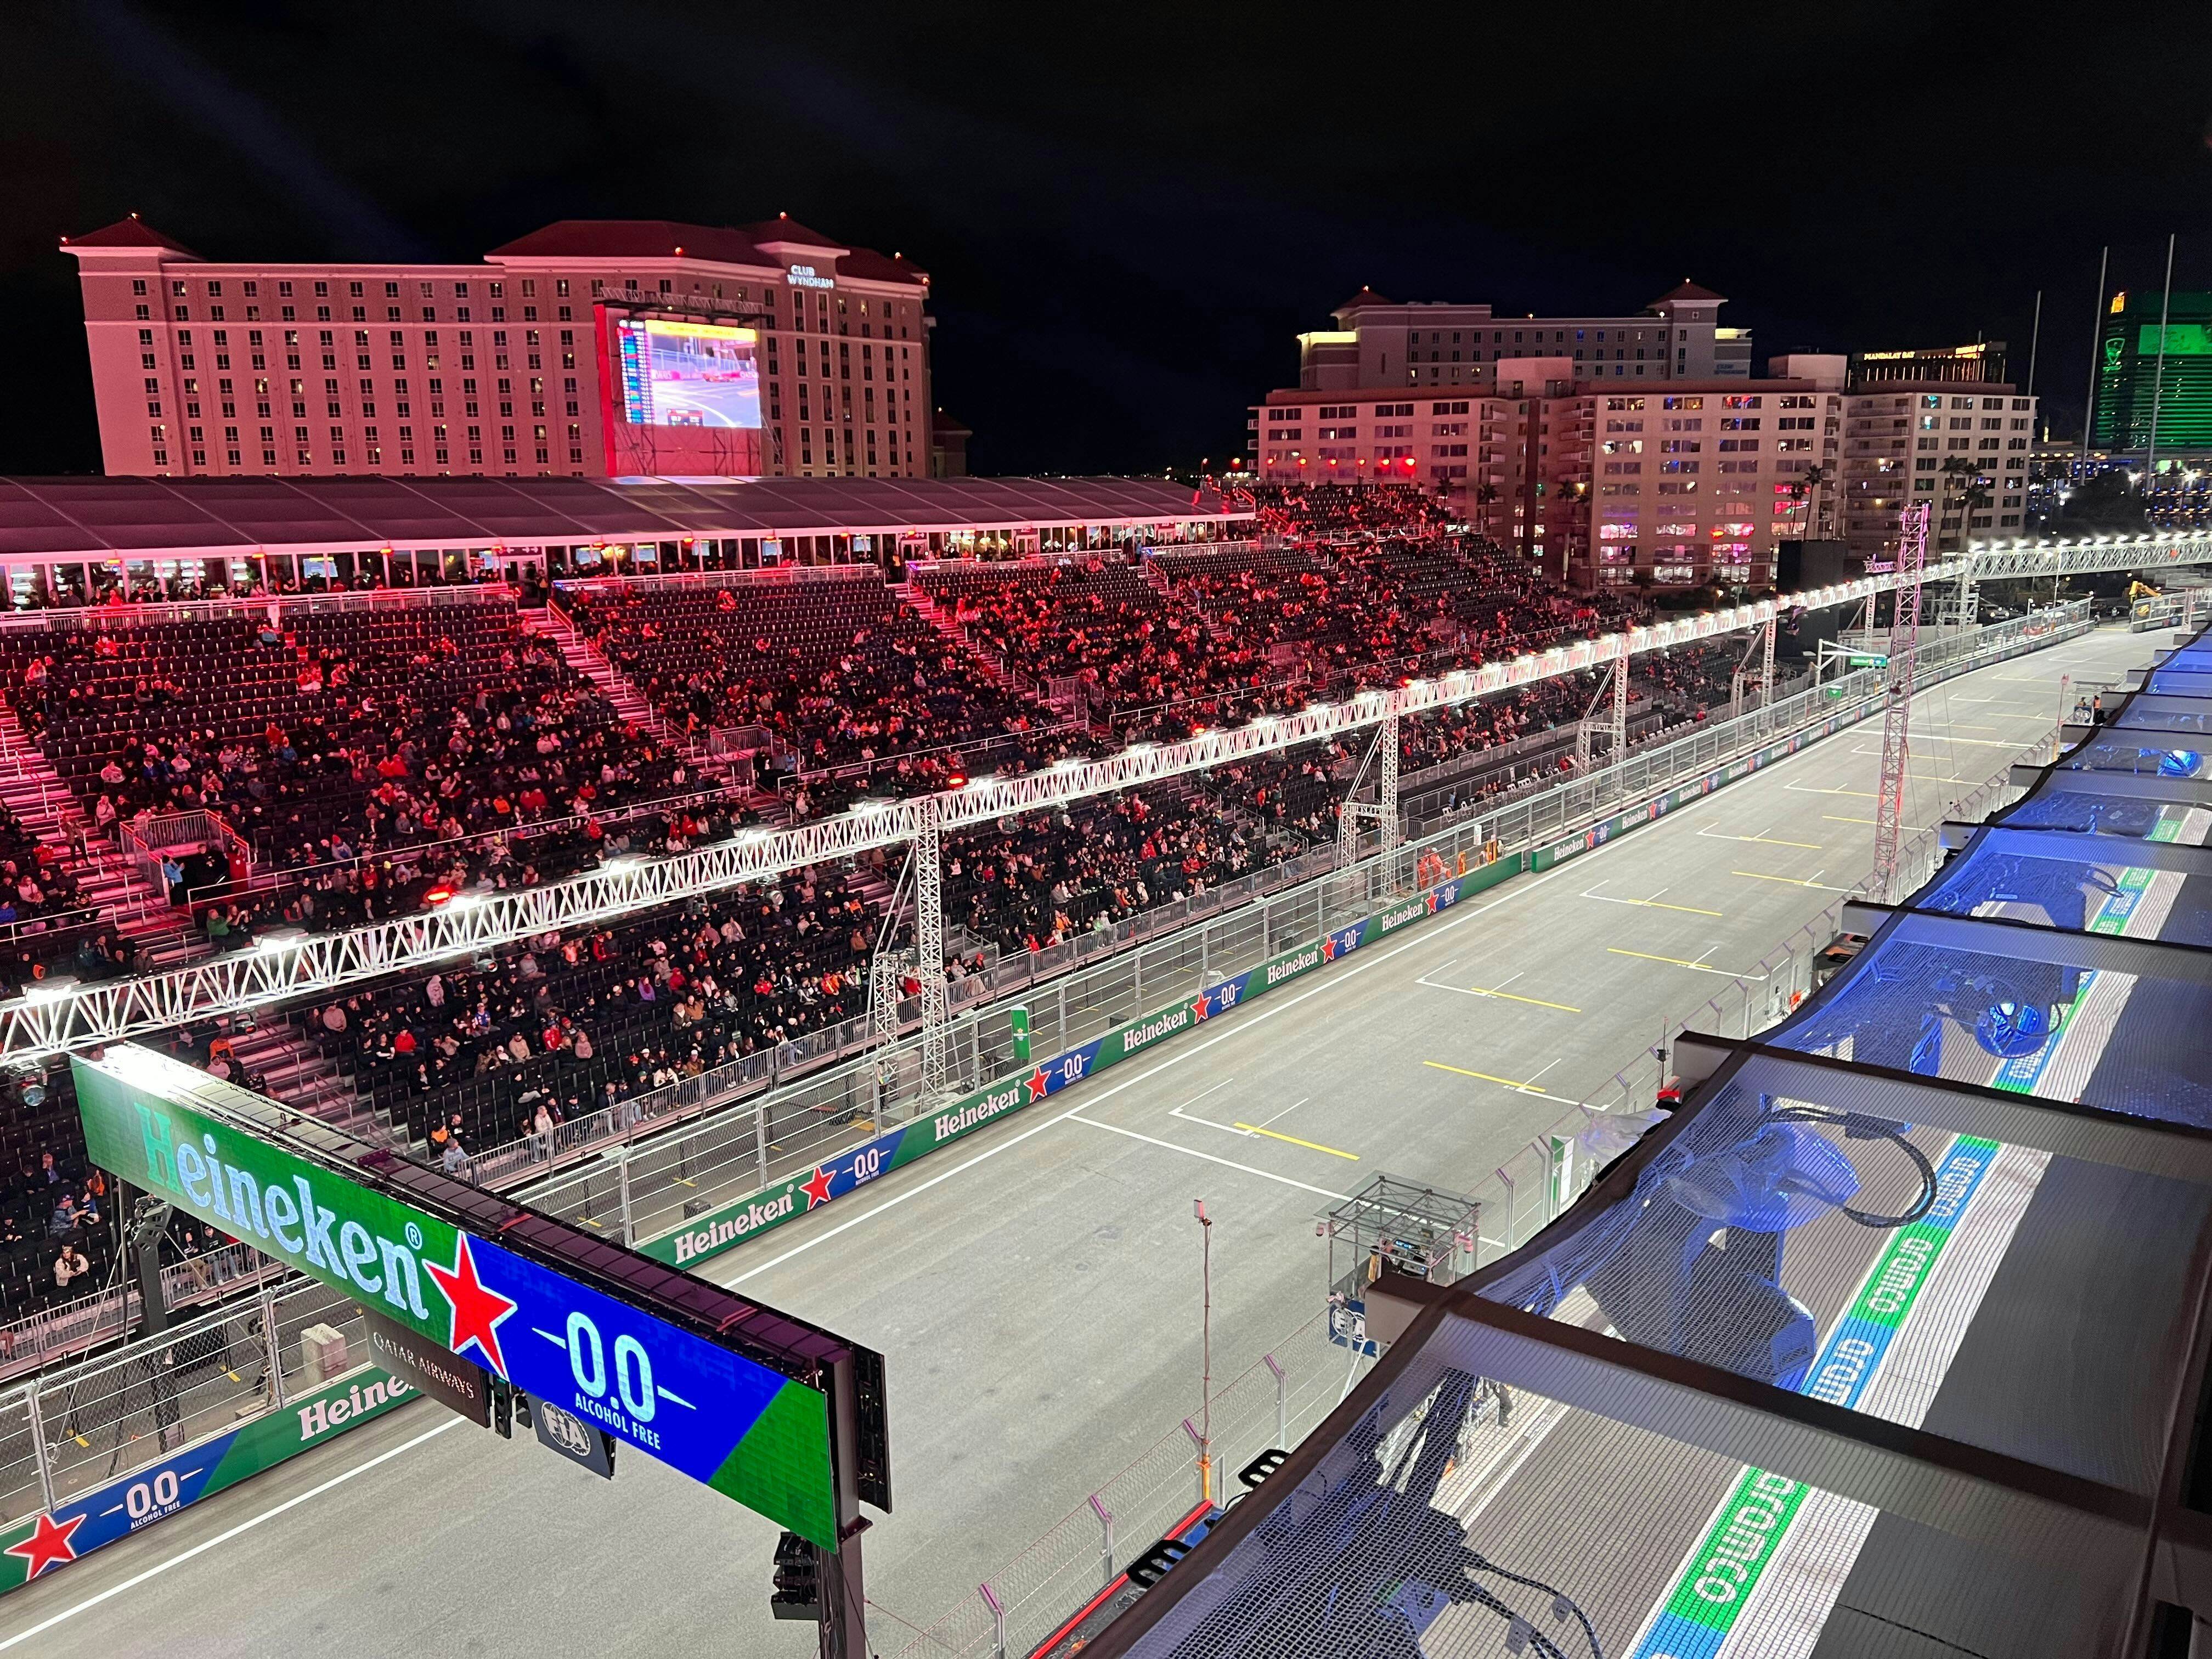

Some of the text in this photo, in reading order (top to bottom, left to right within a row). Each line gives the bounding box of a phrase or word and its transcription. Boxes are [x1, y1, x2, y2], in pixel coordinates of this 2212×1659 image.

[787, 274, 833, 289] WYNDHAM
[791, 264, 815, 277] CLUB
[1554, 838, 1584, 861] Heineken
[1381, 902, 1424, 932] Heineken
[1267, 950, 1318, 985] Heineken
[1123, 1009, 1188, 1052] Heineken
[935, 1087, 1020, 1142] Heineken
[134, 1102, 429, 1320] Heineken
[674, 1193, 794, 1264] Heineken
[1867, 1238, 1934, 1313] aramco
[373, 1331, 476, 1400] QATAR AIRWAYS
[297, 1375, 415, 1441] Heine
[575, 1392, 661, 1450] ALCOHOL FREE
[131, 1500, 180, 1530] ALCOHOL FREE
[1694, 1472, 1796, 1603] aramco
